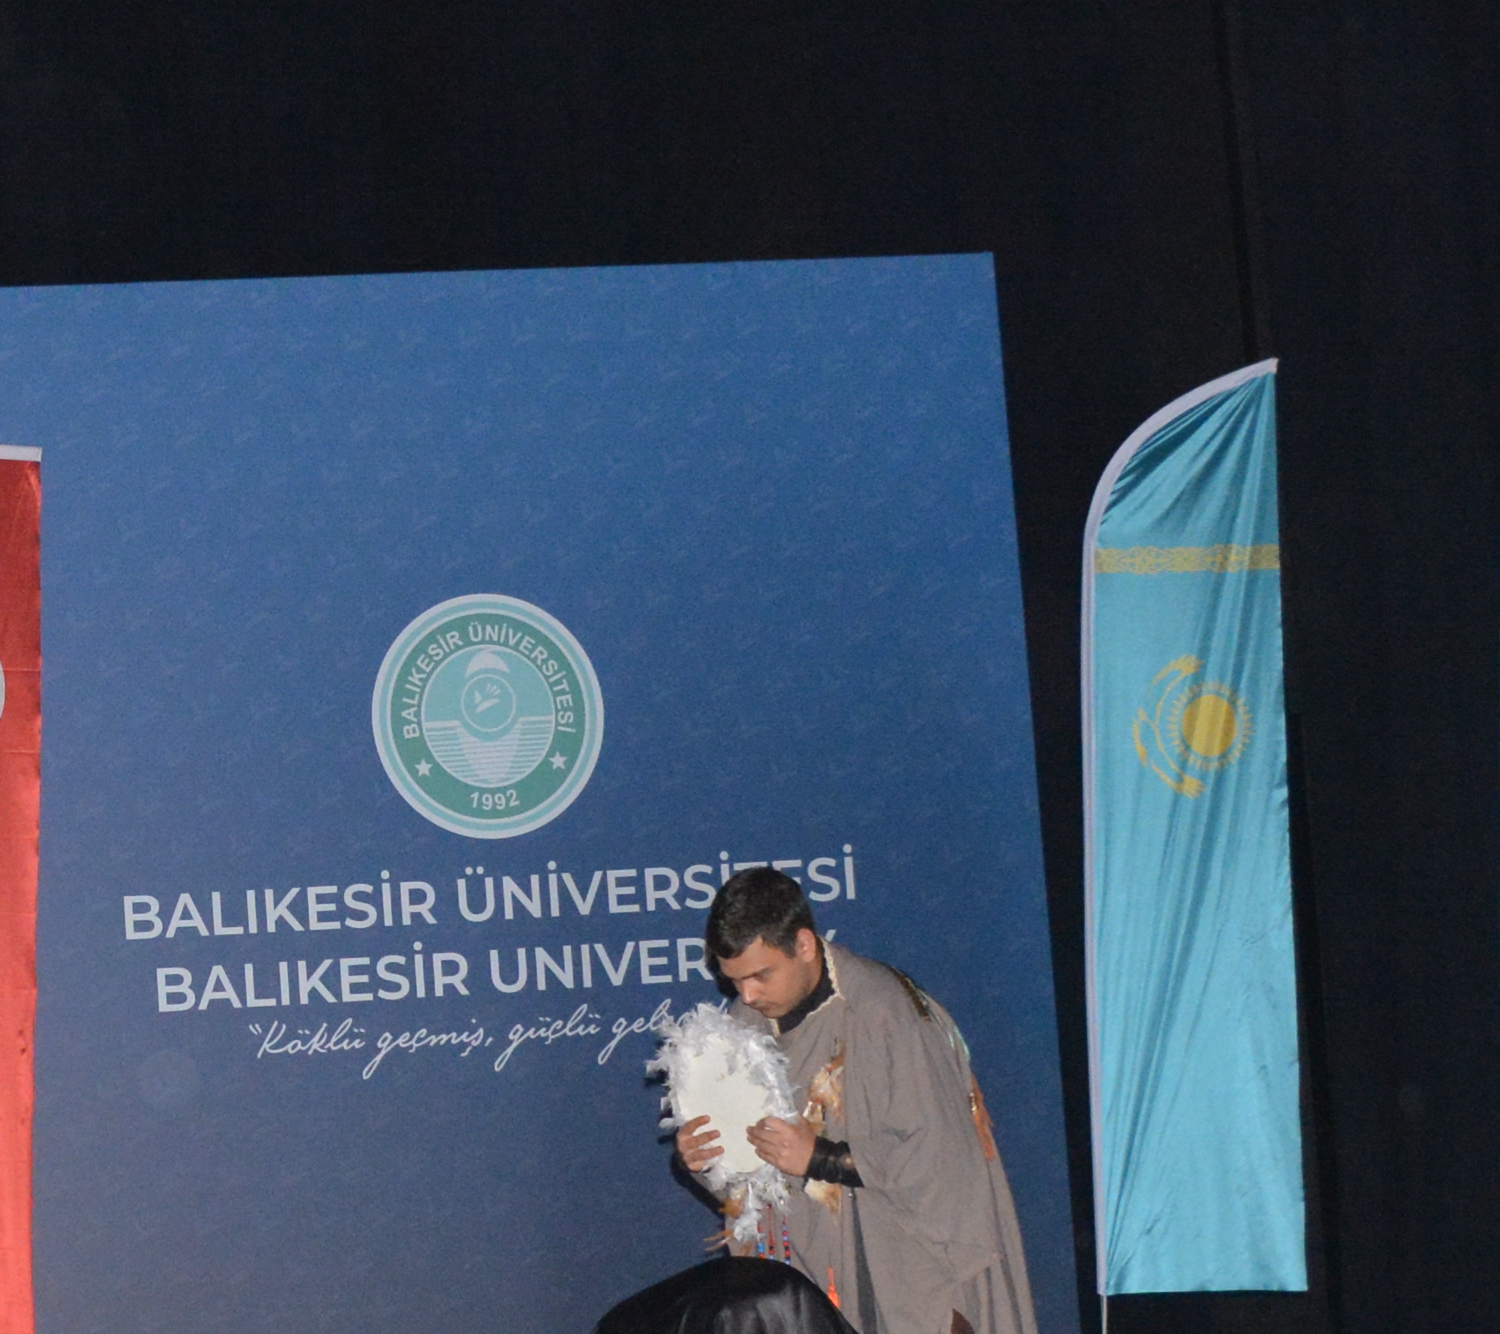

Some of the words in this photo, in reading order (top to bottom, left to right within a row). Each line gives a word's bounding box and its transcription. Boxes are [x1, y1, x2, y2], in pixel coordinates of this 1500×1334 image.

[471, 789, 520, 811] 1992
[123, 869, 438, 941] BALIKESİR
[156, 940, 470, 1013] BALIKESİR
[489, 929, 836, 994] UNIVER
[494, 1003, 600, 1072] güçlü
